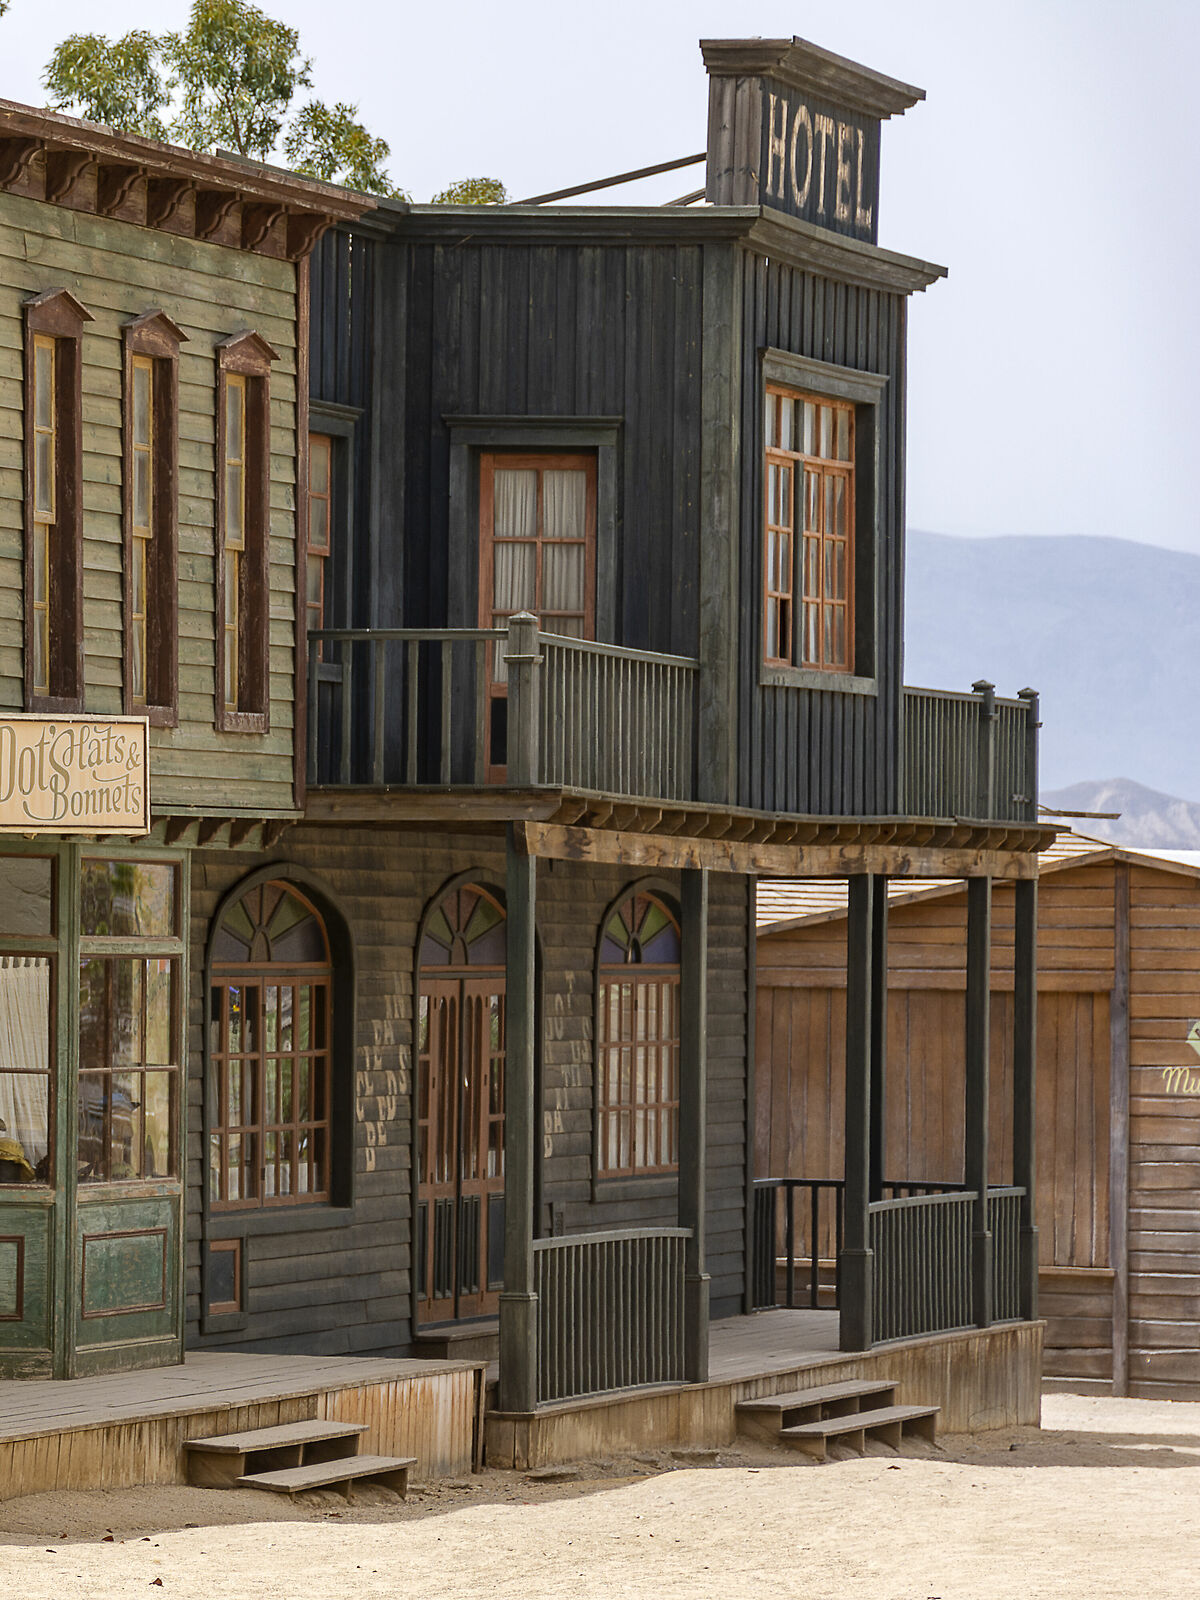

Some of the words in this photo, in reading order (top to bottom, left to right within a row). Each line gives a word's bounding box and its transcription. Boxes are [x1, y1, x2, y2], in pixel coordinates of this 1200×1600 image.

[765, 93, 873, 230] HOTEL
[126, 741, 142, 771] &
[23, 770, 142, 821] Bonnets
